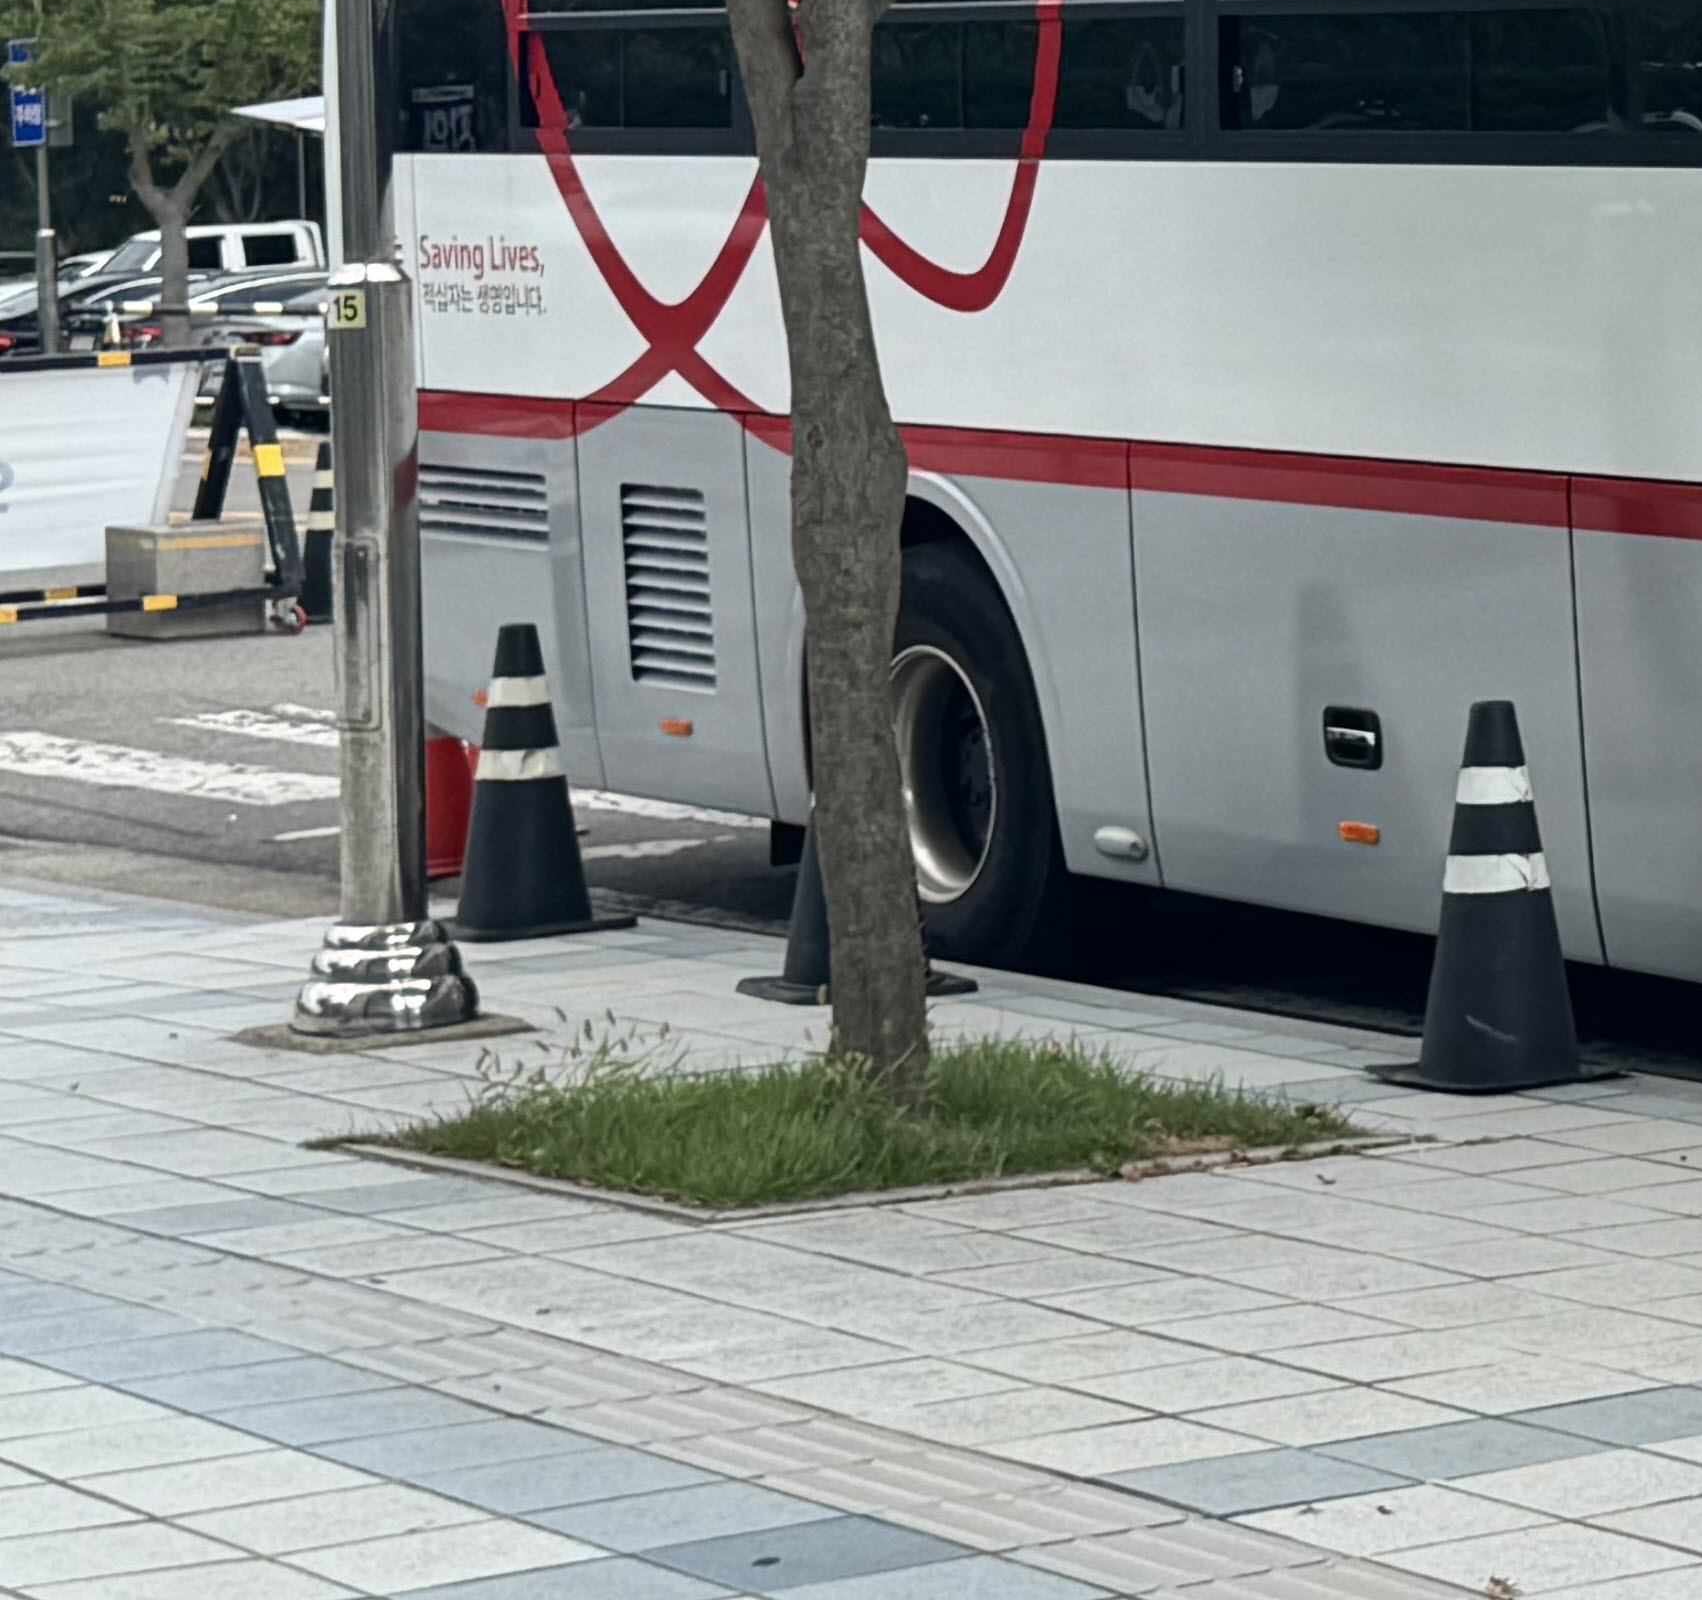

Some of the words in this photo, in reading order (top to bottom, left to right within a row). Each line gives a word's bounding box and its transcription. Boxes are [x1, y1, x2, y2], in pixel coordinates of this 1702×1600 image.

[419, 234, 484, 279] Saving
[489, 234, 545, 277] Lives,
[332, 295, 358, 322] 15
